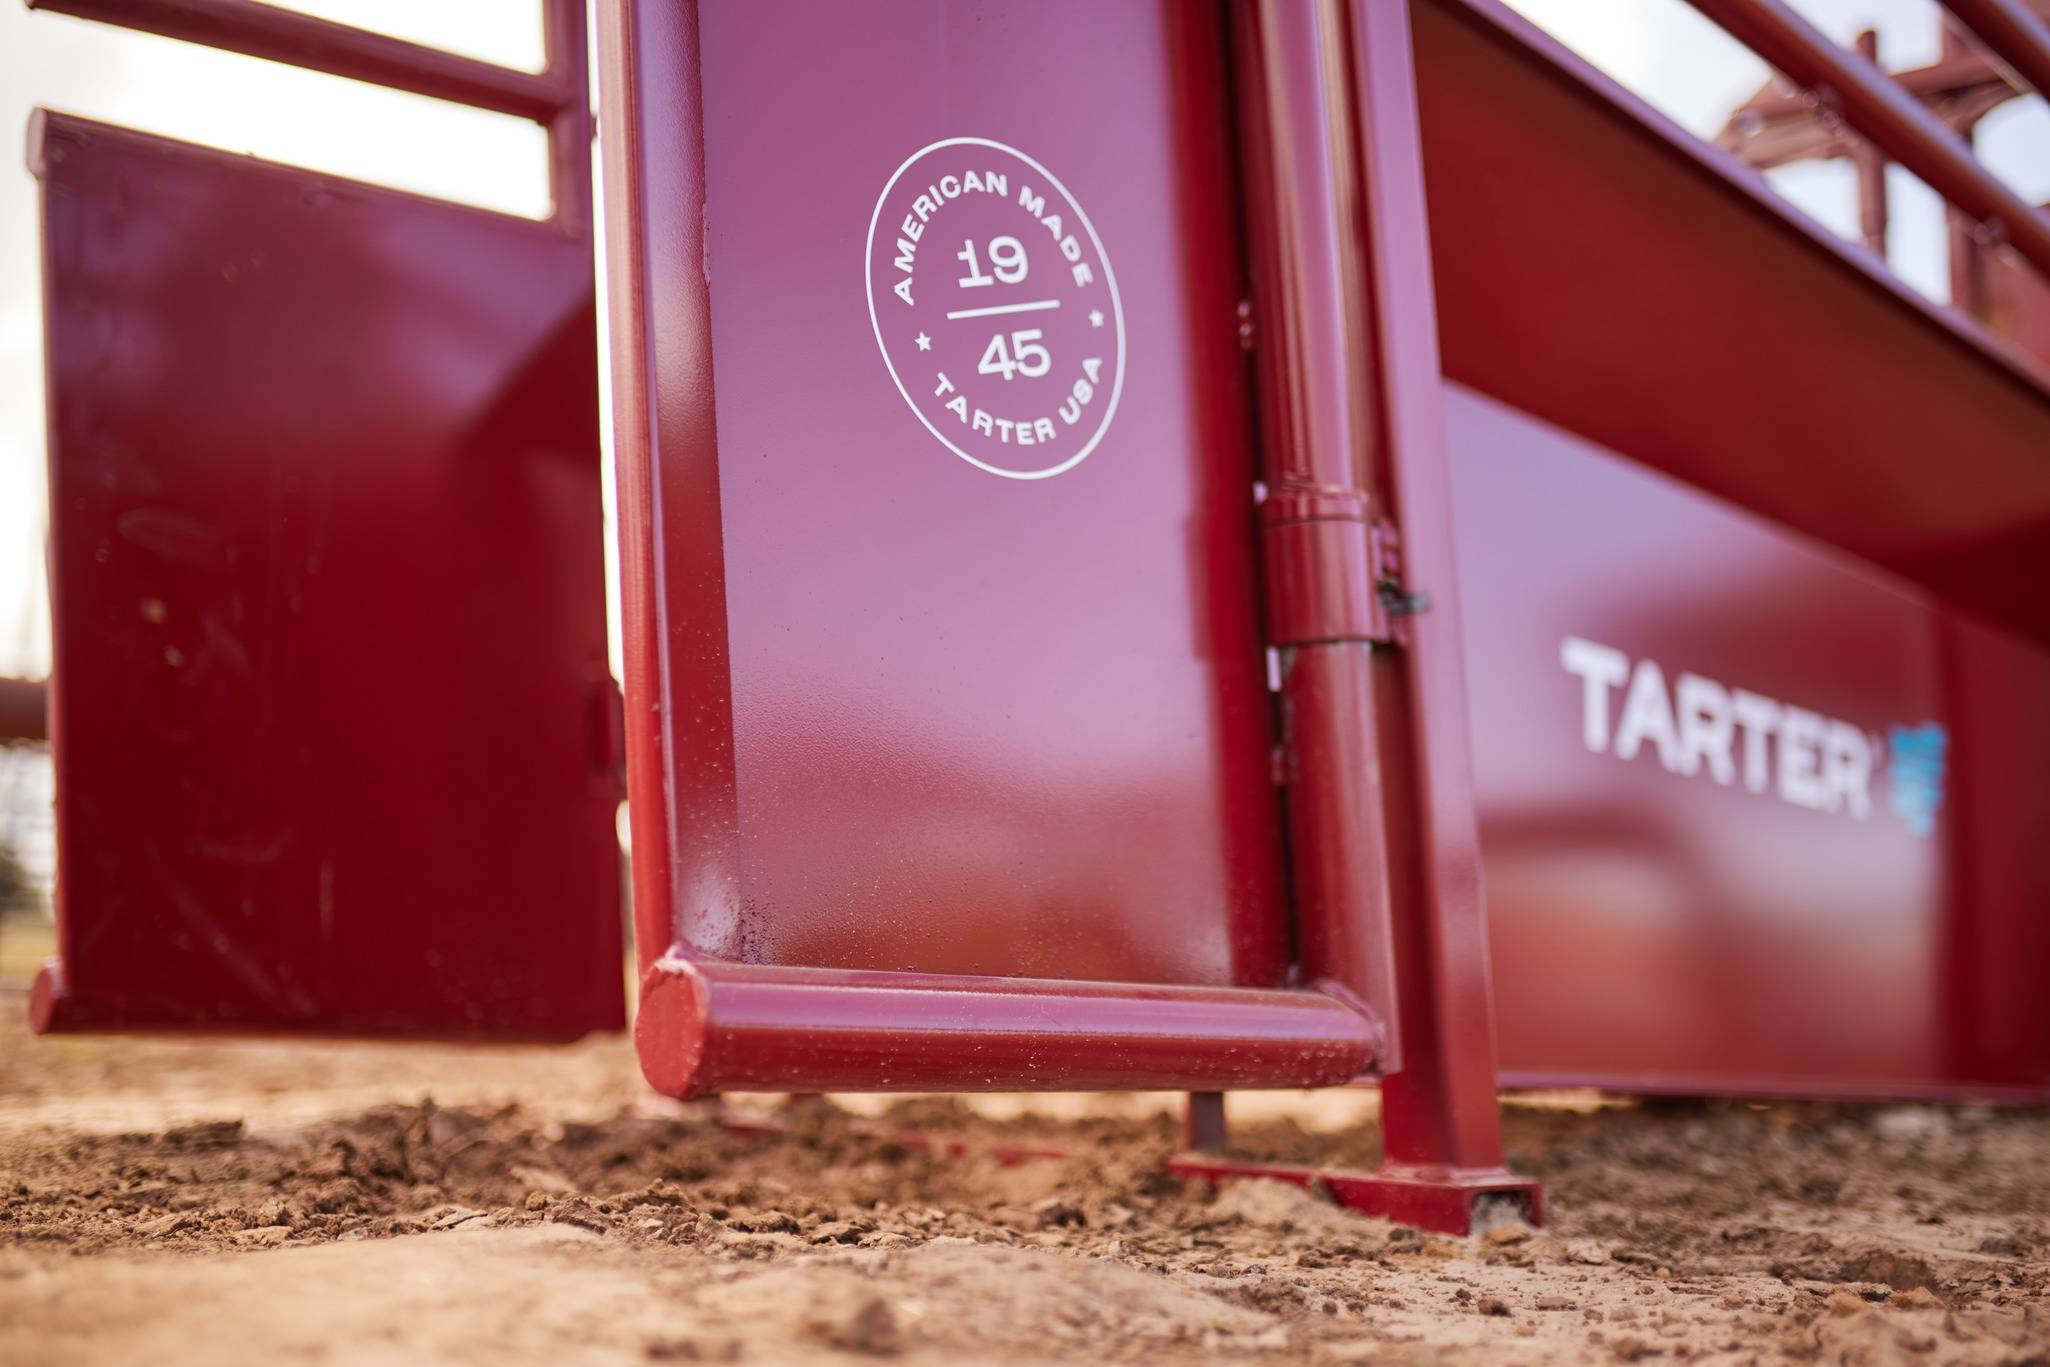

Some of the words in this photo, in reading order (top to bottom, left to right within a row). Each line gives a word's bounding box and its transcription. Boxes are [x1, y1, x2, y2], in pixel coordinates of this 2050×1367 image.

[893, 170, 1008, 306] AMERICAN
[1018, 185, 1094, 288] MADE
[957, 235, 1029, 288] 19
[977, 328, 1051, 381] 45
[933, 372, 1056, 445] TARTER
[1058, 357, 1102, 425] USA
[1560, 635, 1871, 821] TARTER
